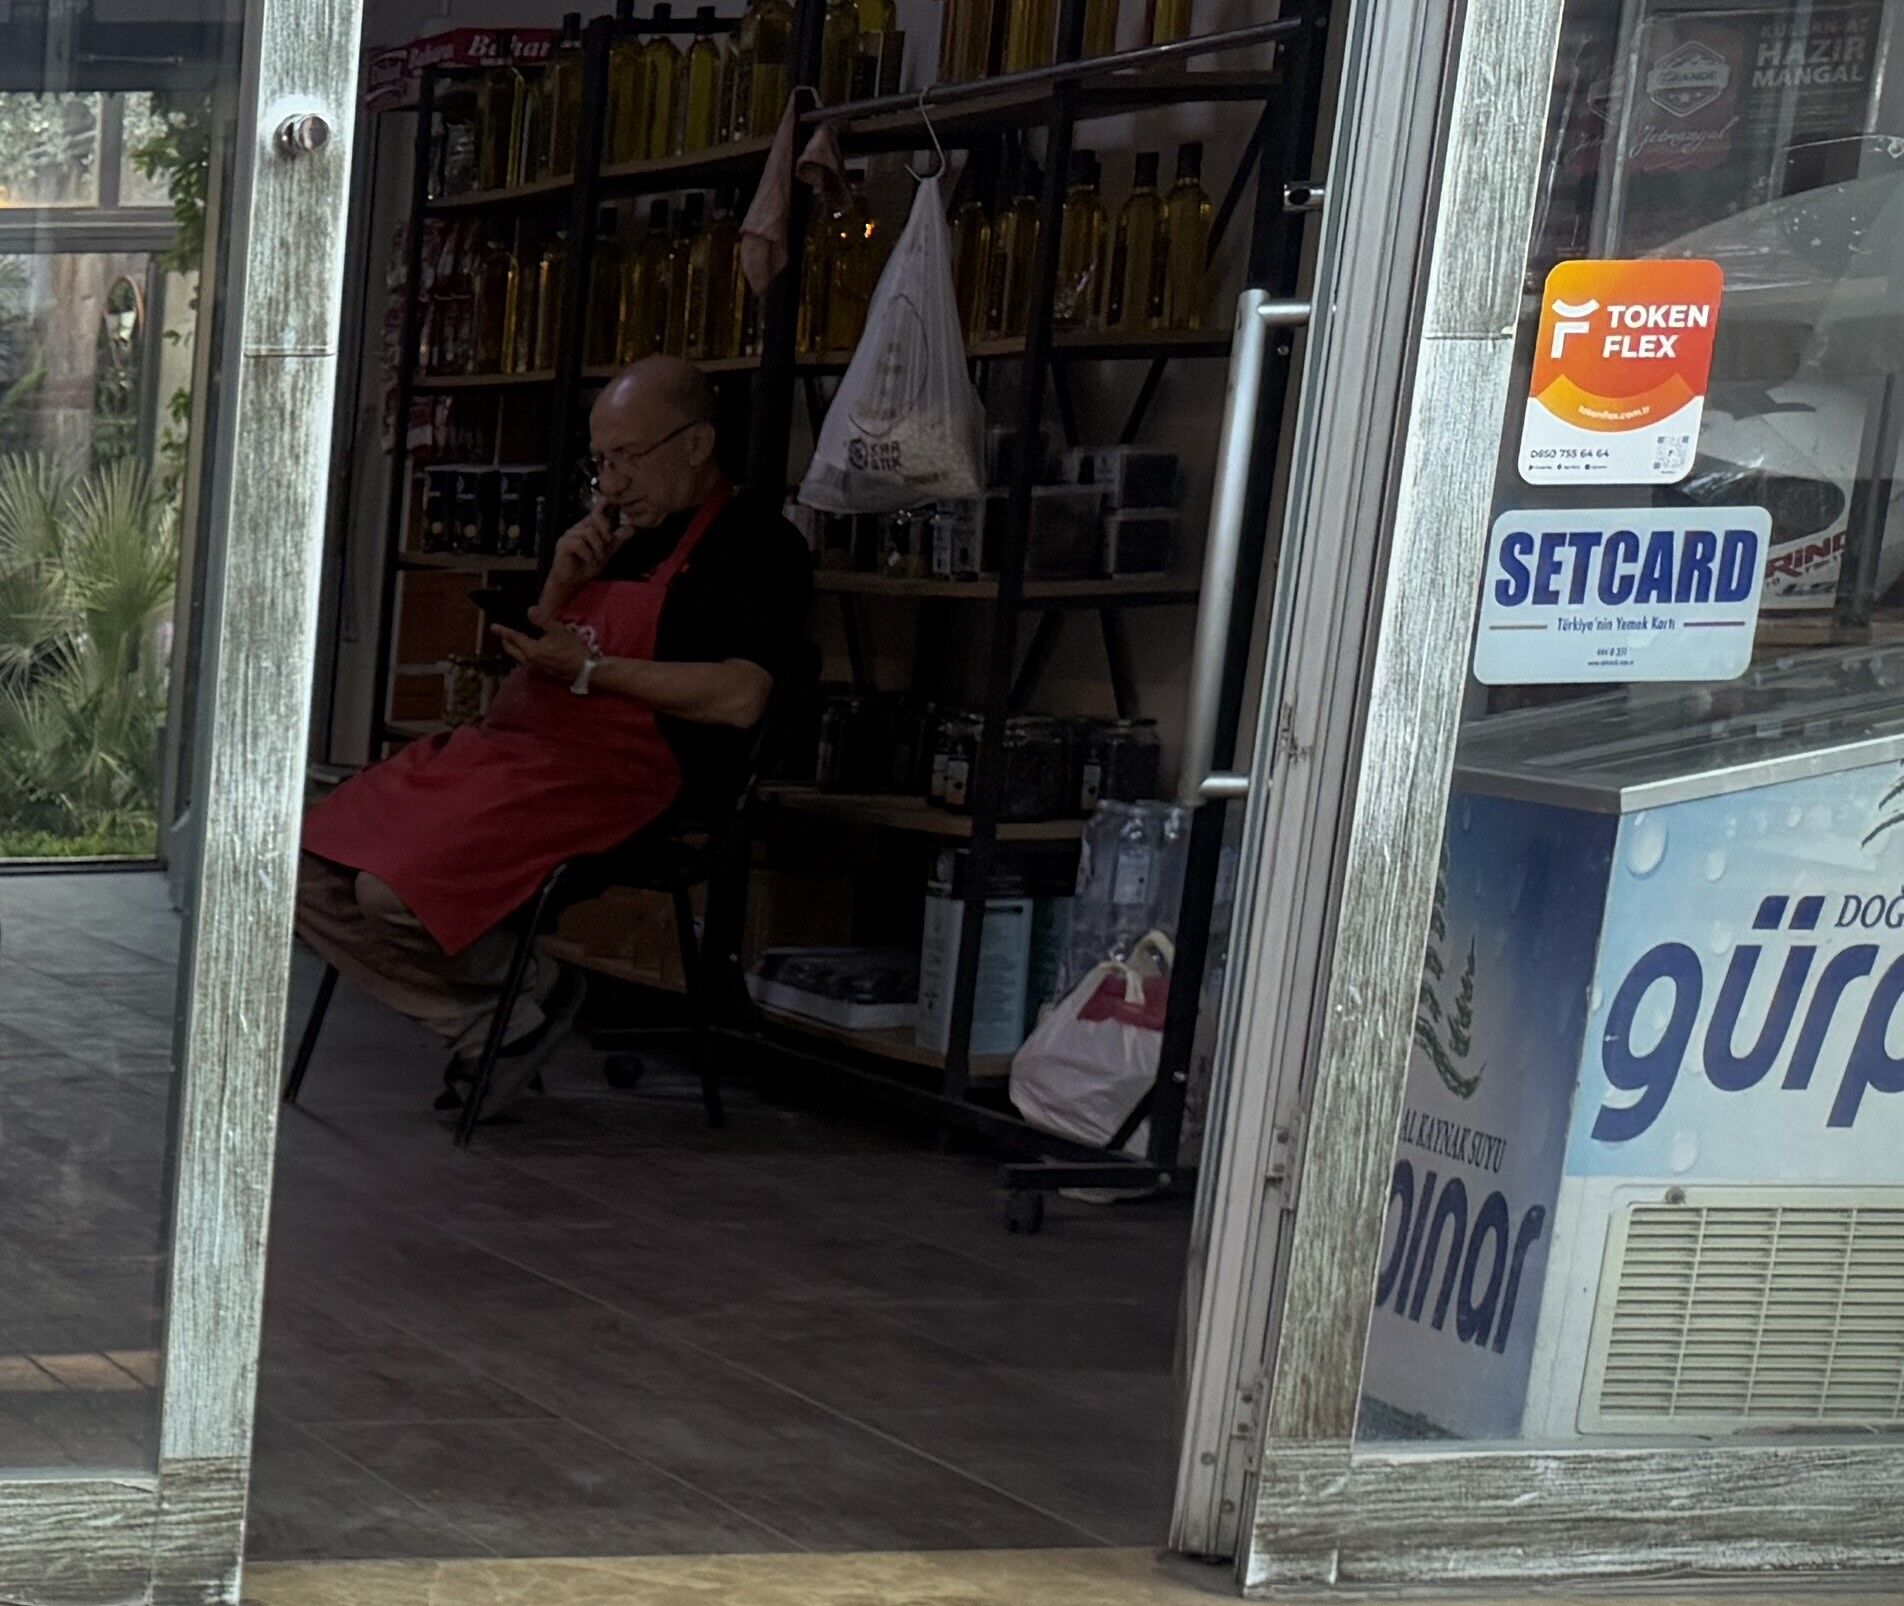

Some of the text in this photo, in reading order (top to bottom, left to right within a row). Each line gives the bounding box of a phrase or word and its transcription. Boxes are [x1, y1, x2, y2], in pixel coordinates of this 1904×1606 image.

[1750, 63, 1864, 89] MANGAL
[1606, 304, 1710, 329] TOKEN
[1602, 334, 1679, 359] FLEX
[1494, 530, 1758, 608] SETCARD
[1557, 616, 1613, 634] Türkiye'nin
[1616, 615, 1648, 630] Yemek
[1415, 1112, 1472, 1163] KAYNAK
[1467, 1130, 1507, 1174] SUYU
